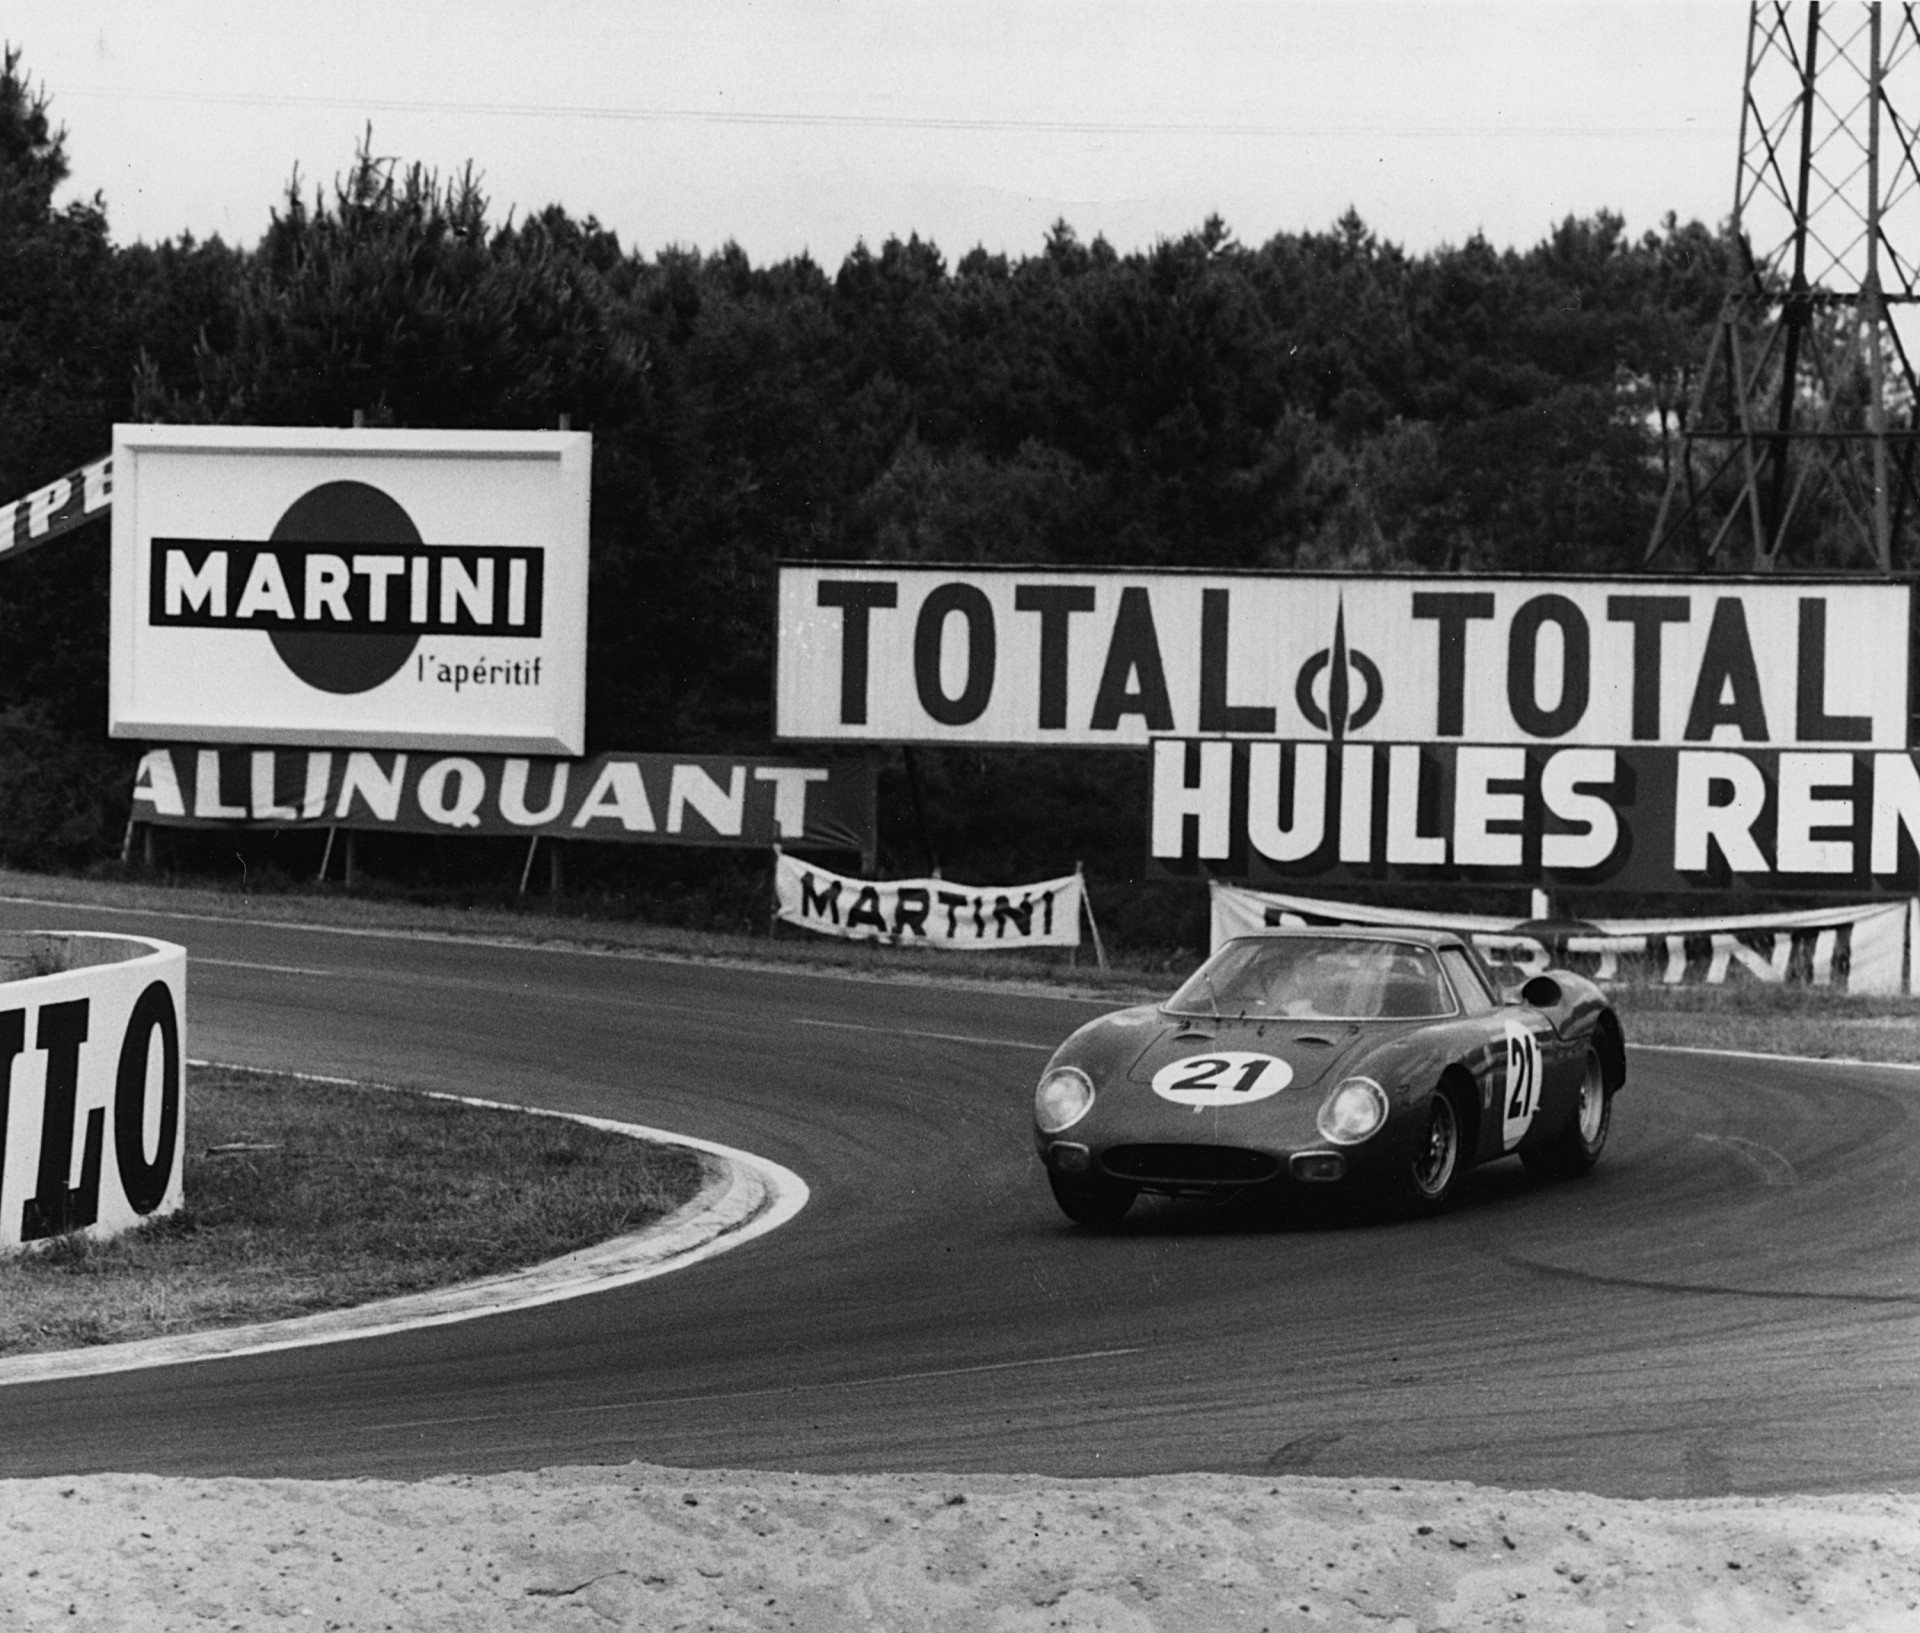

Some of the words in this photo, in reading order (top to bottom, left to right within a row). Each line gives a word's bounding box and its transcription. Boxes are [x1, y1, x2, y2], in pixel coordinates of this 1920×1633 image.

[165, 549, 528, 626] MARTINI
[418, 653, 542, 692] l'apéritif
[817, 580, 1276, 733] TOTAL
[1412, 592, 1873, 742] TOTAL
[133, 749, 829, 838] ALLINQUANT
[1151, 740, 1619, 868] HUILES
[801, 872, 1054, 938] MARTINI
[1169, 1059, 1271, 1092] 21
[1507, 1034, 1533, 1120] 21
